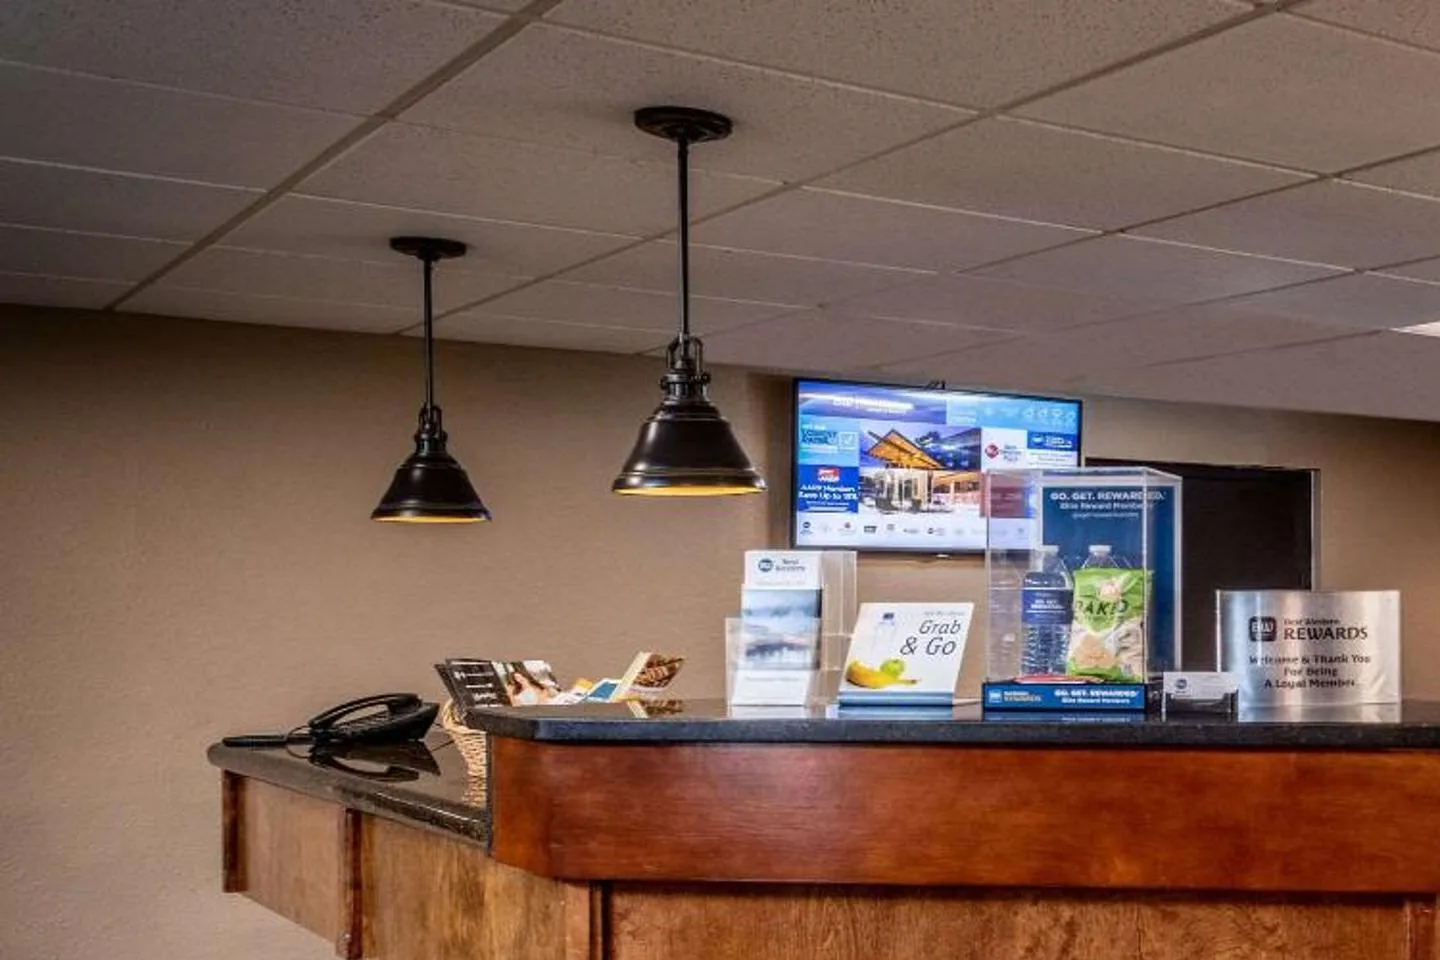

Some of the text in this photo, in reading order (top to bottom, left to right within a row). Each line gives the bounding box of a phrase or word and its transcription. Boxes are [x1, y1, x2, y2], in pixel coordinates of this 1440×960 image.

[919, 619, 961, 635] Grab
[1283, 626, 1368, 641] REWARDS
[900, 636, 957, 656] & Go
[1314, 654, 1349, 664] Thank
[1350, 653, 1371, 664] You
[1264, 679, 1273, 689] A
[1275, 679, 1307, 691] Loyal
